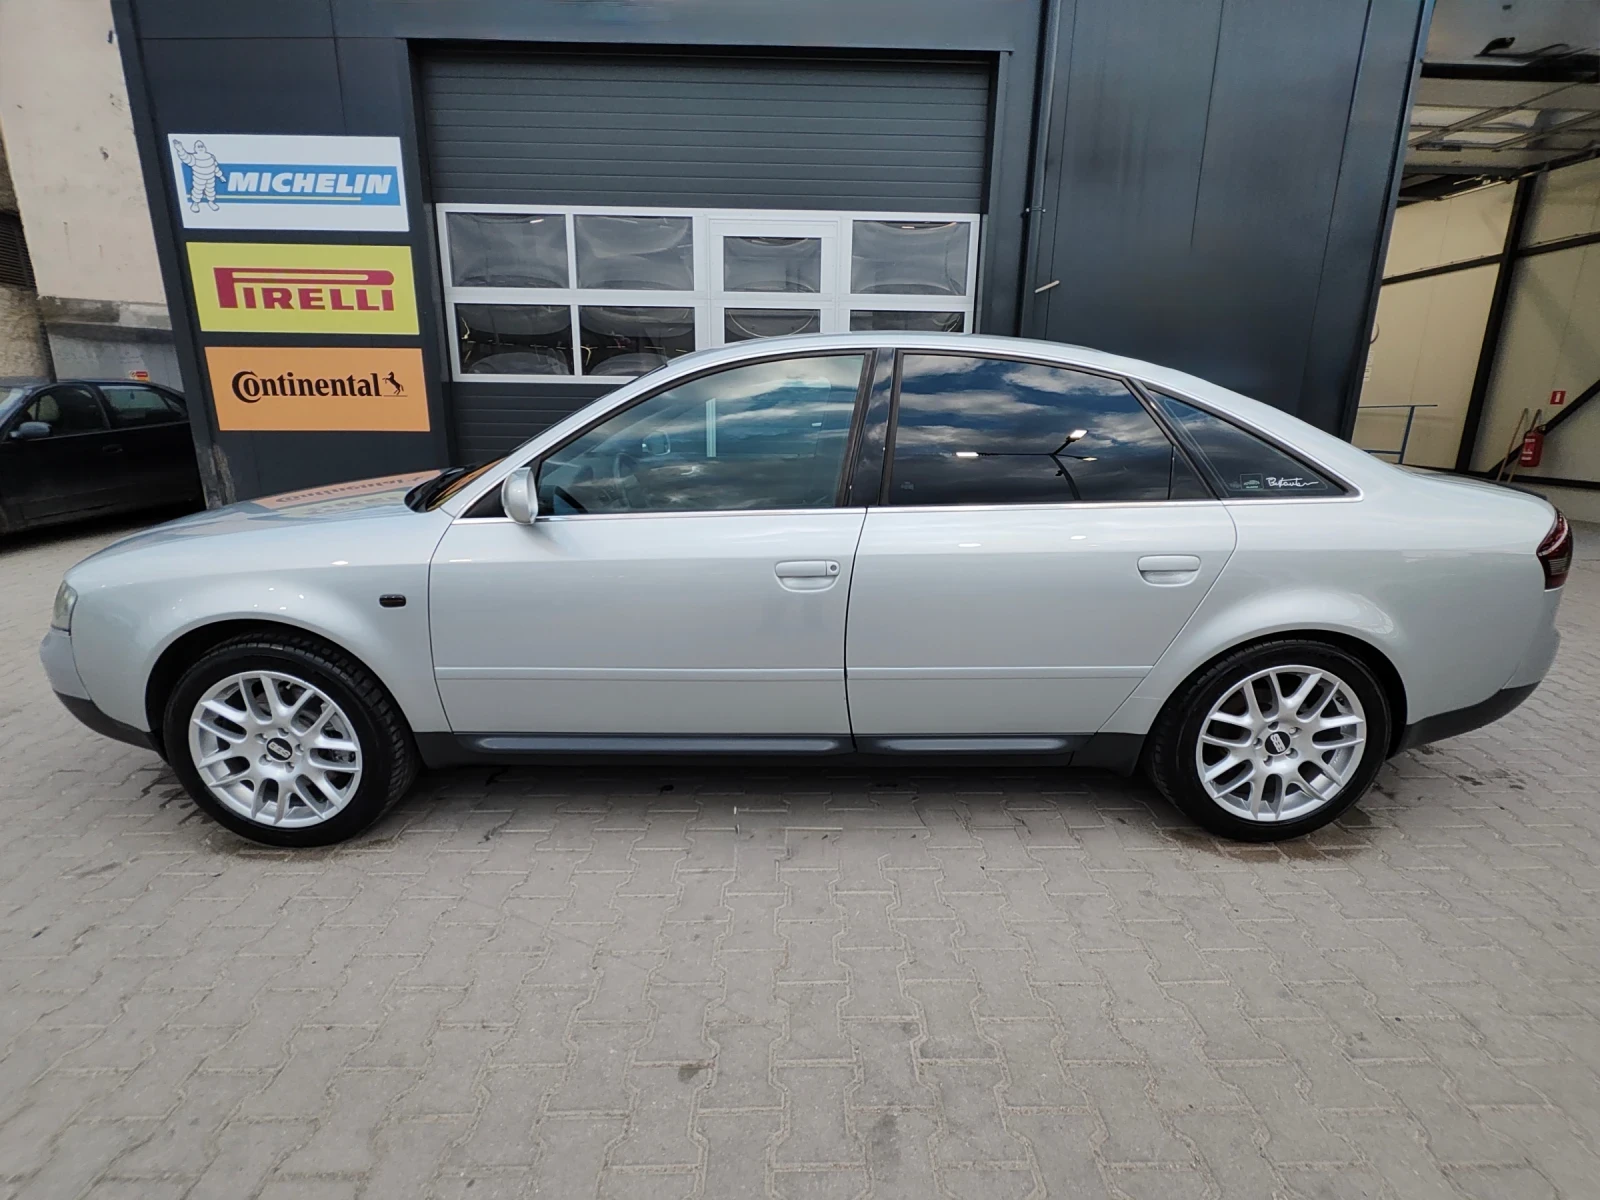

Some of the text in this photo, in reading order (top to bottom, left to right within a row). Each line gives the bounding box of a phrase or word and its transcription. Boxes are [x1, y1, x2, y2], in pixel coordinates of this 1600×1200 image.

[227, 172, 392, 195] MICHELIN
[213, 267, 394, 311] PIRELLI
[231, 370, 382, 404] Continental
